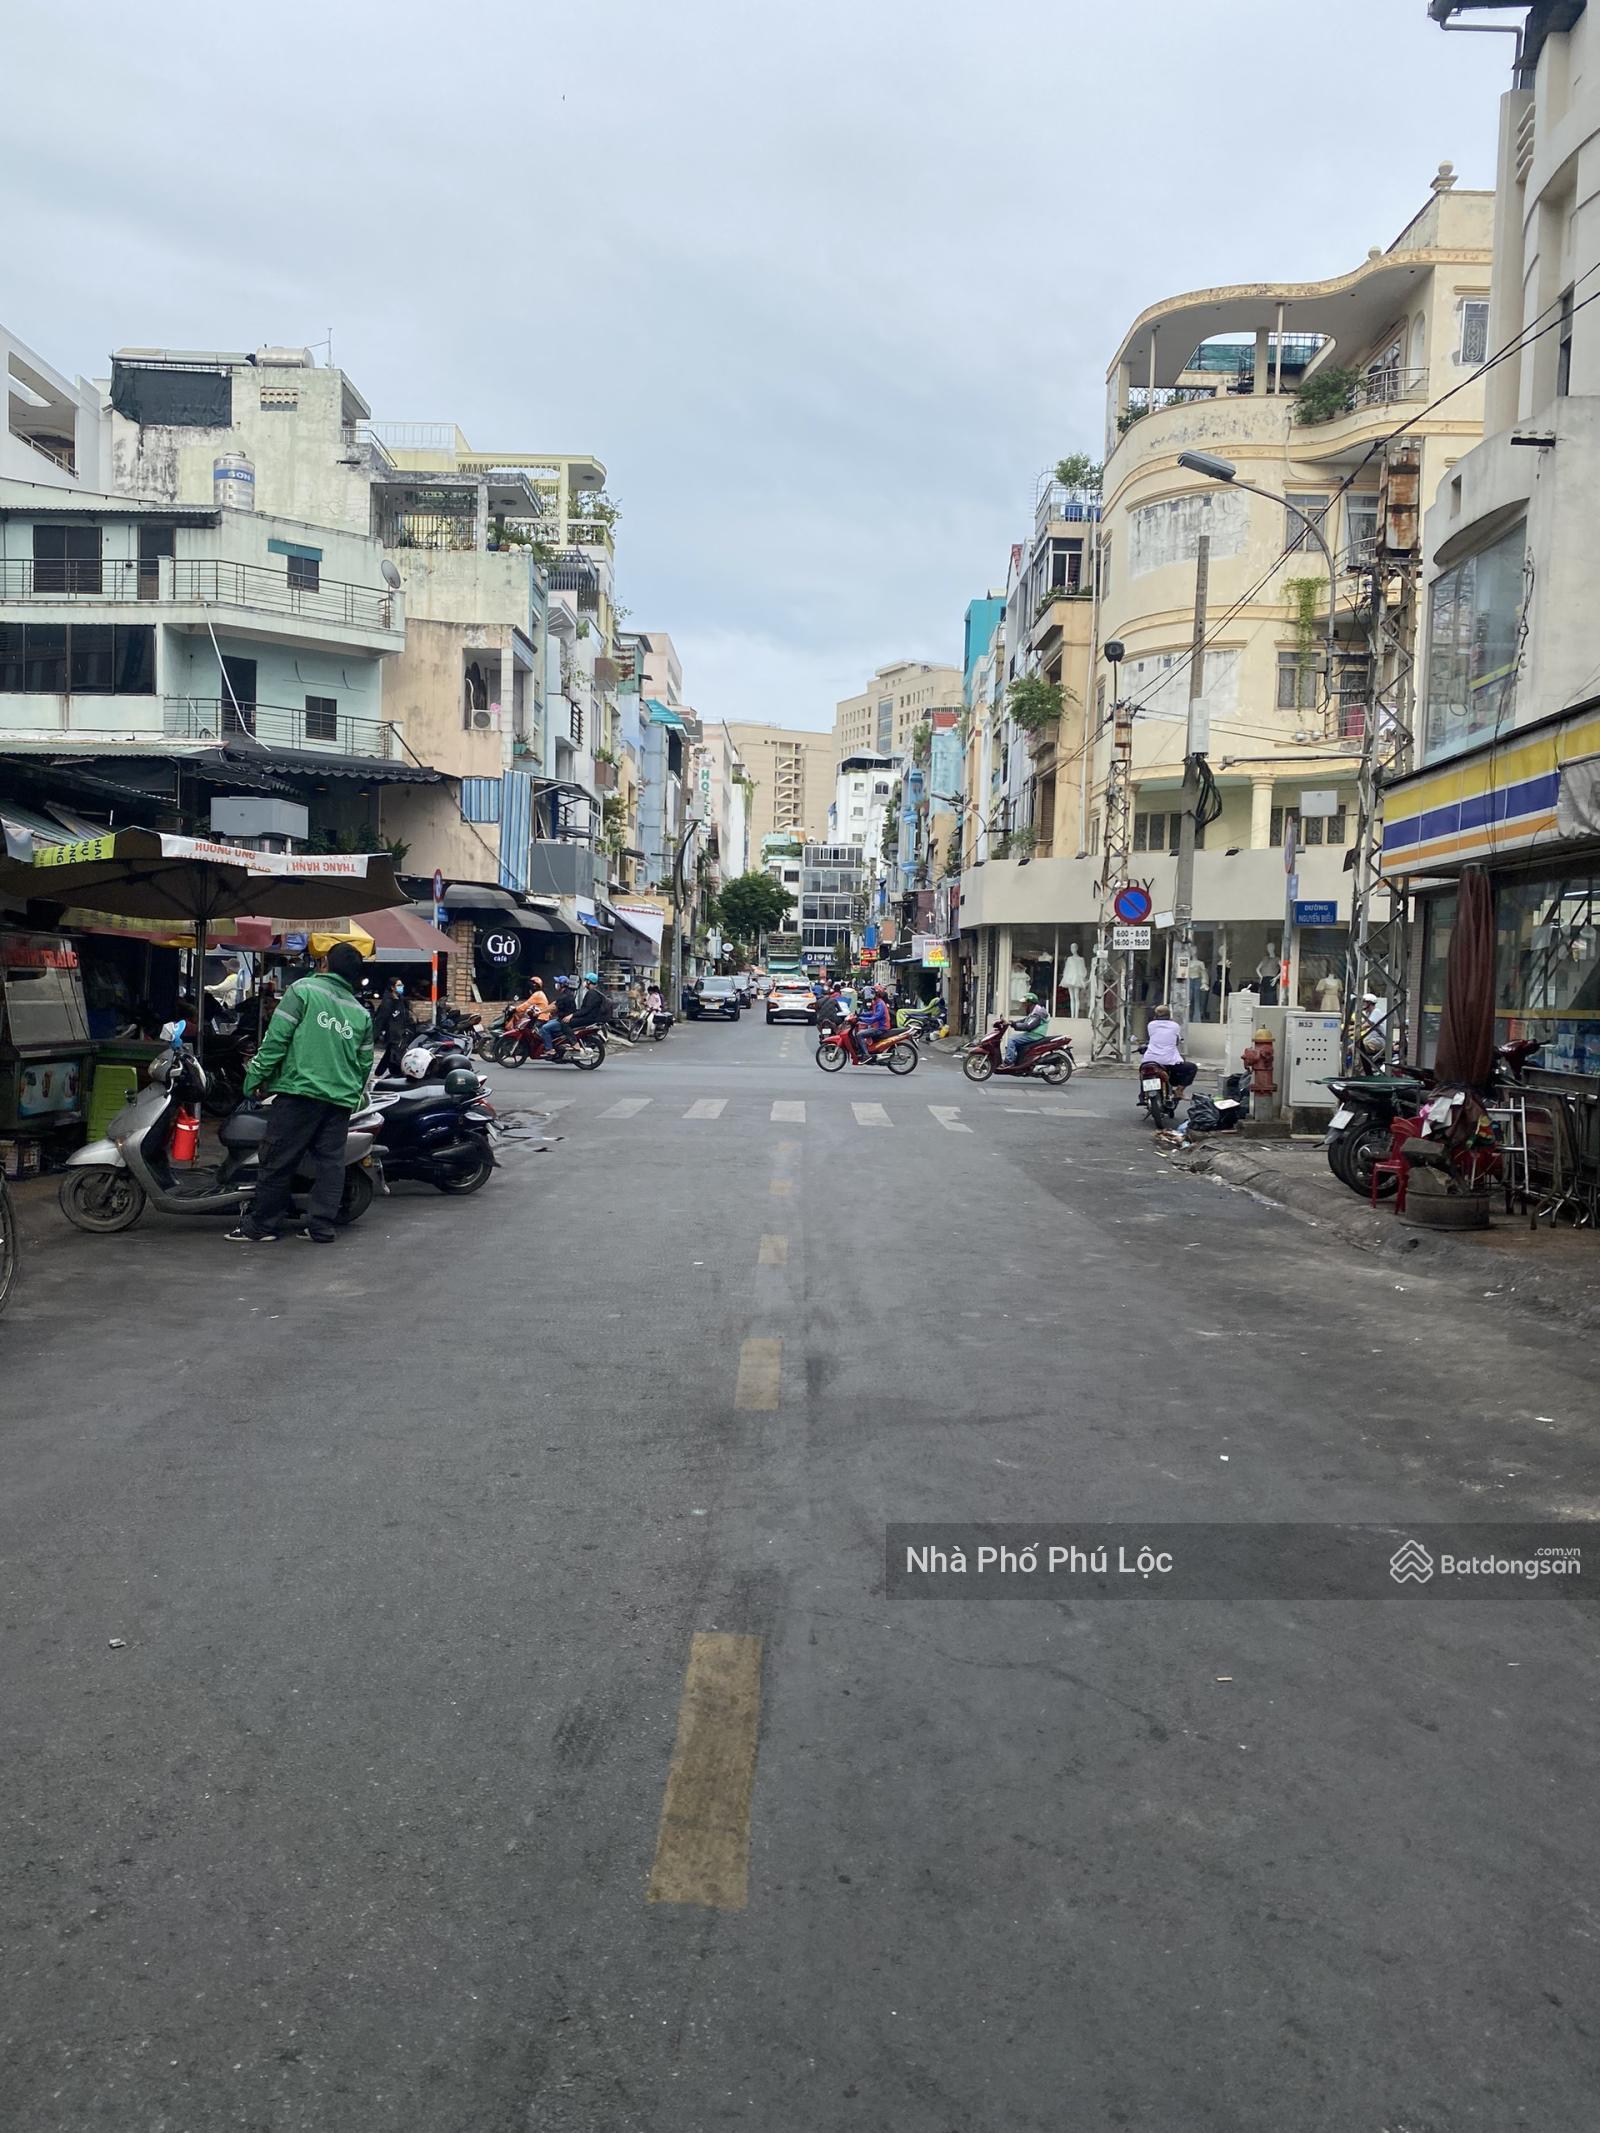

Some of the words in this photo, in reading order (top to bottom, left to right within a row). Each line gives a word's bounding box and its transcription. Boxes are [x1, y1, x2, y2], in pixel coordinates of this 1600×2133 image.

[487, 934, 516, 955] Gờ
[1114, 938, 1130, 946] 16:00
[317, 1011, 354, 1040] Grab
